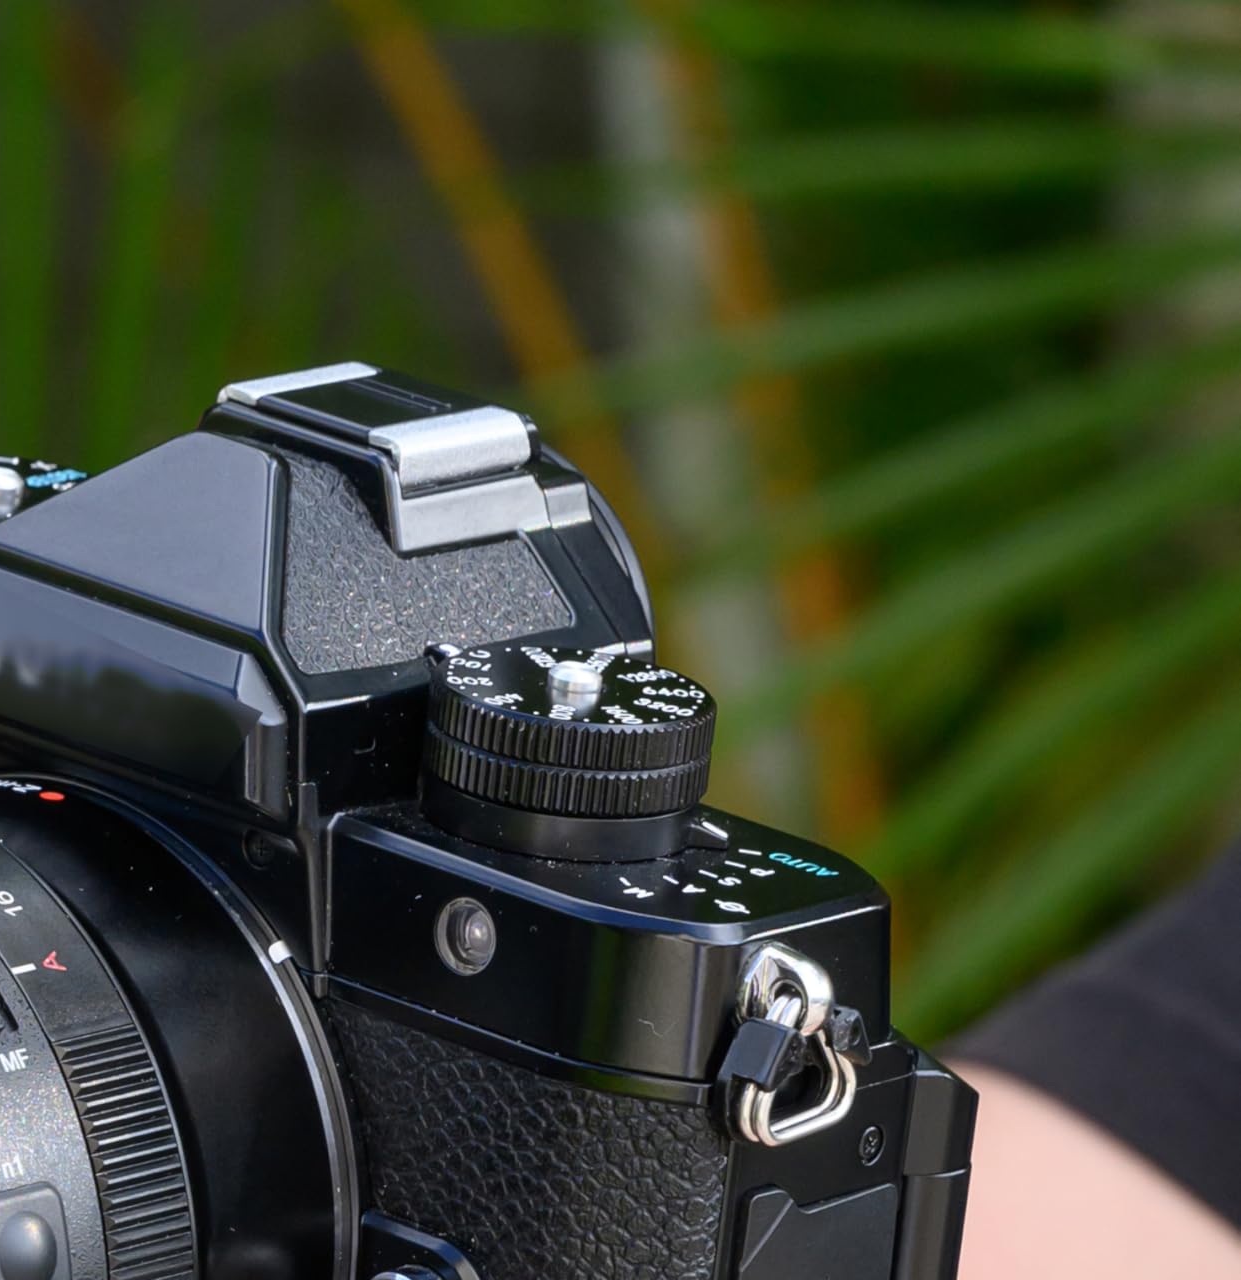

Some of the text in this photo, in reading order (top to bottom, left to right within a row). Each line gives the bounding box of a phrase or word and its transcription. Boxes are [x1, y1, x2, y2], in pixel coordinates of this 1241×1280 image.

[449, 657, 492, 672] 100
[446, 675, 494, 687] 200
[642, 685, 706, 700] 6400
[633, 698, 696, 717] 3200
[768, 851, 840, 877] AUTO
[749, 867, 776, 877] P
[716, 875, 742, 887] S
[43, 951, 67, 971] A
